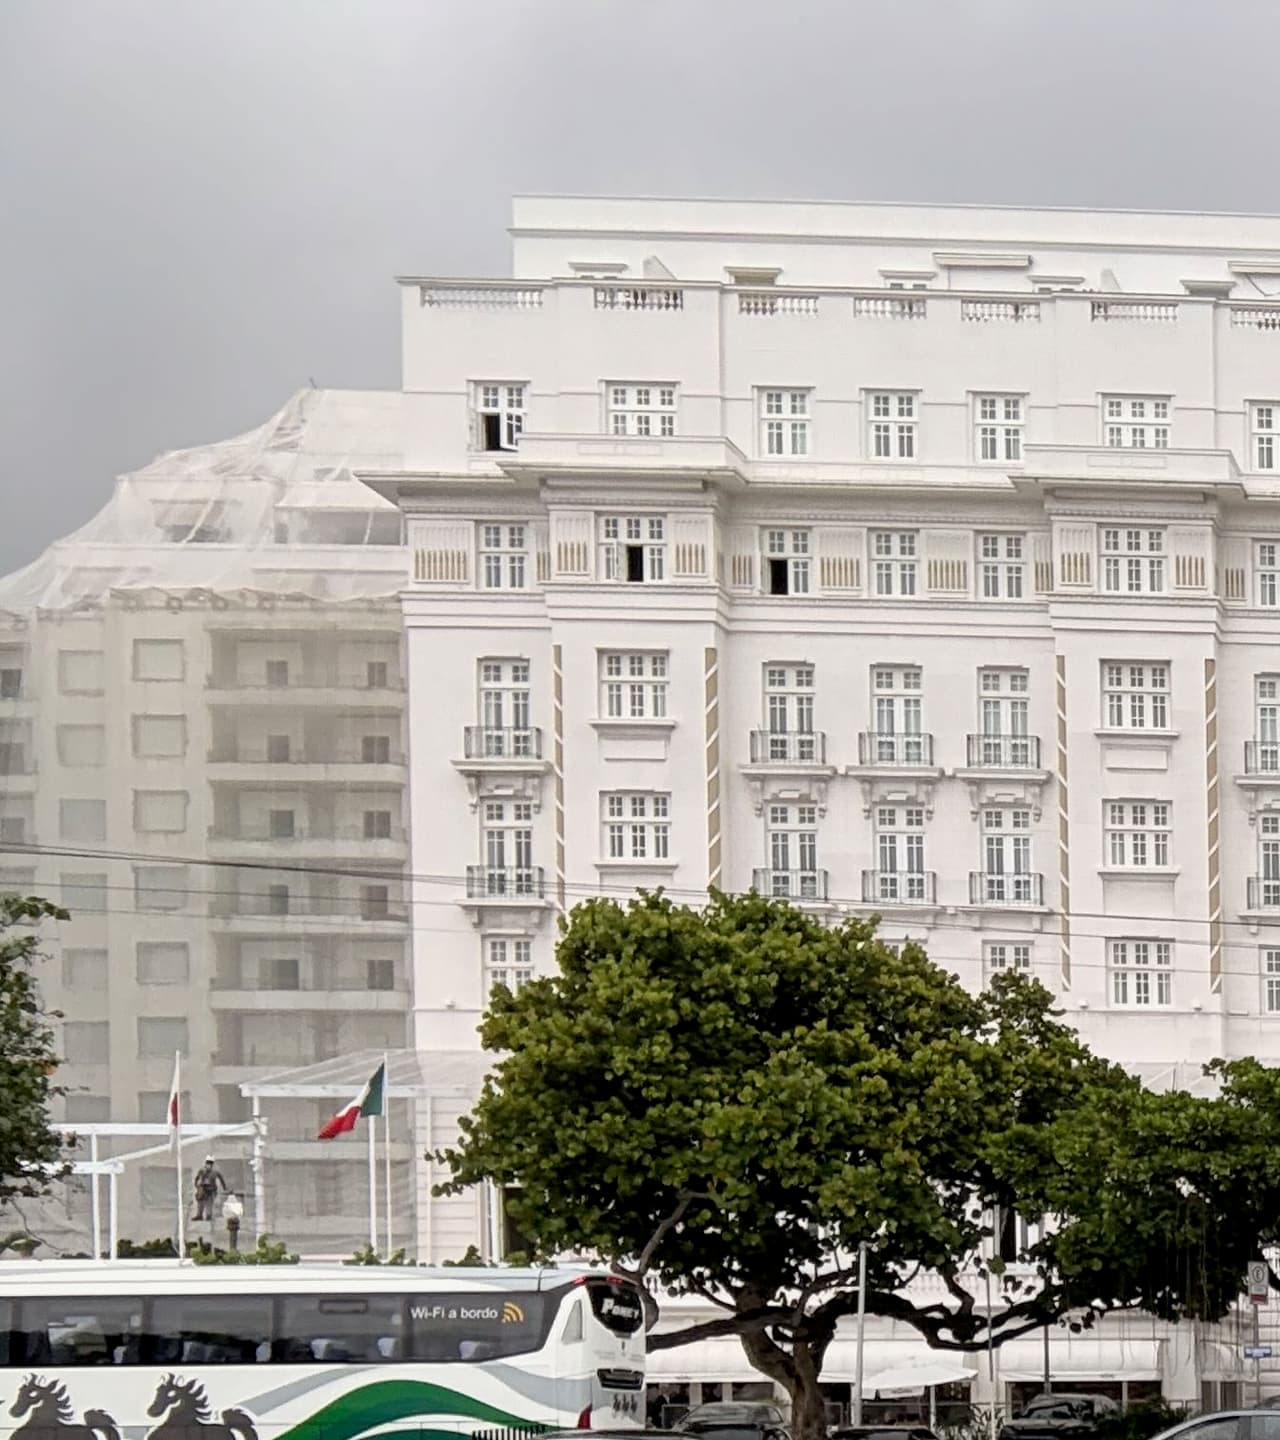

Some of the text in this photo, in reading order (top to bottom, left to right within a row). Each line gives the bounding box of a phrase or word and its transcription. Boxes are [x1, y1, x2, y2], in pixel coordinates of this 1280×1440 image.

[410, 1306, 498, 1319] Wi-Fi a bordo
